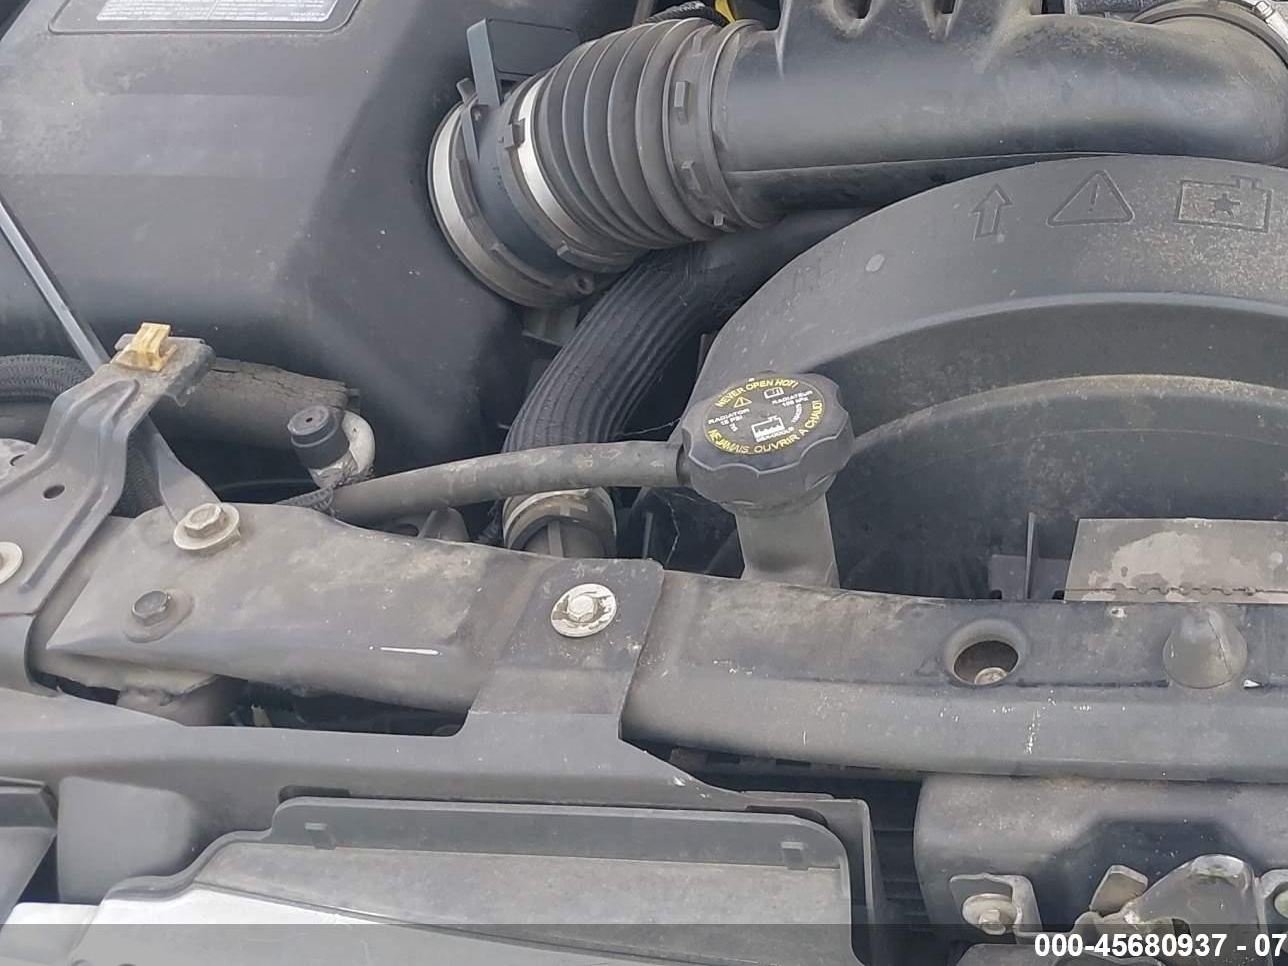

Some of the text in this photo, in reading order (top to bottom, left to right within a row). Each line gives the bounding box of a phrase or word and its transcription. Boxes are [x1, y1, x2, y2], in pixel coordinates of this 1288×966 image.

[715, 379, 799, 408] NEVER OPEN HOT!
[708, 408, 751, 425] RADIATOR
[714, 438, 750, 453] JAMAIS
[754, 434, 801, 453] OUVRIR
[804, 400, 823, 429] CHAUD!
